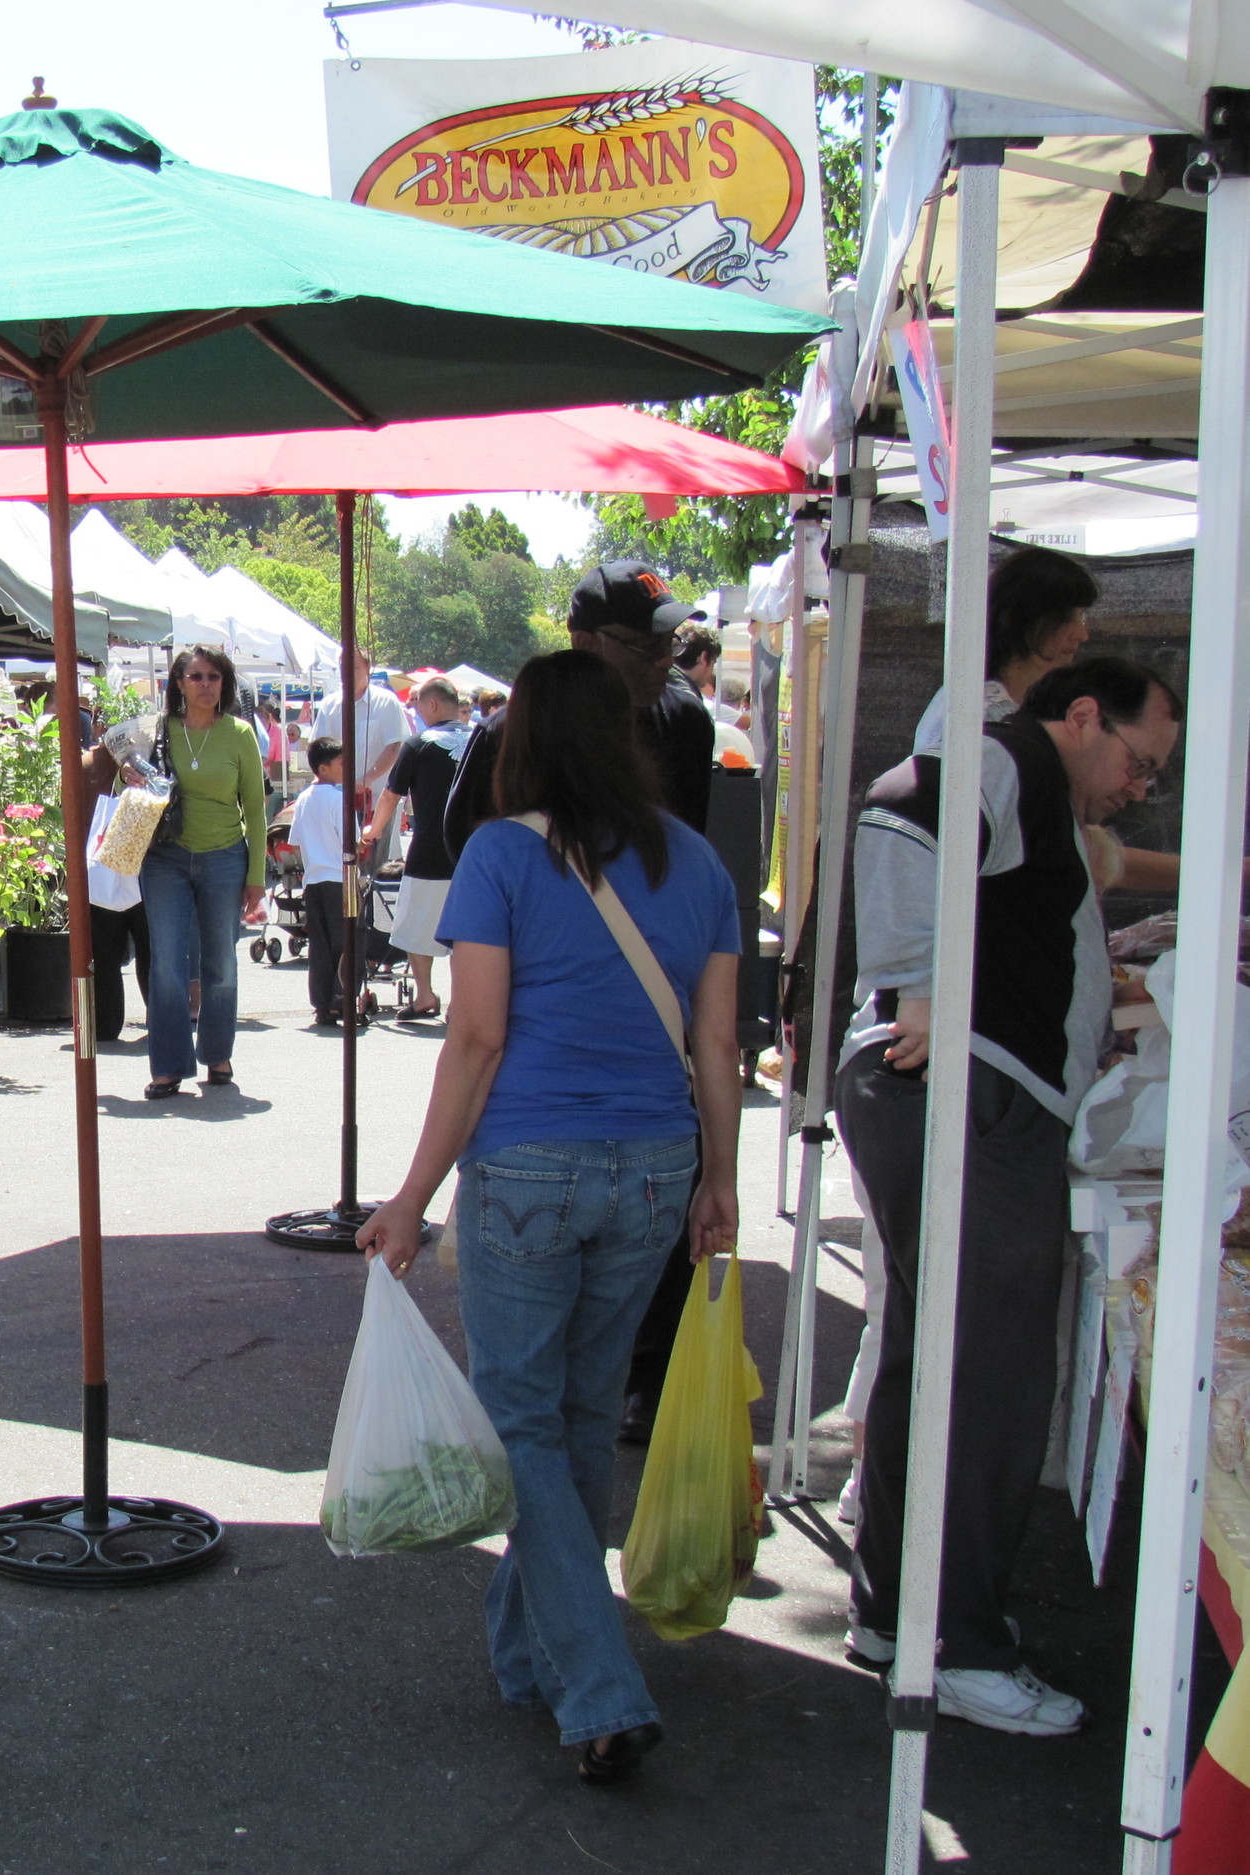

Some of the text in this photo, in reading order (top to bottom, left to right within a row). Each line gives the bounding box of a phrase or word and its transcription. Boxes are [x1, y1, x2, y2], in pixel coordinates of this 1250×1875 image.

[411, 118, 738, 206] BECKMANN'S
[443, 187, 698, 218] Old World Bakery
